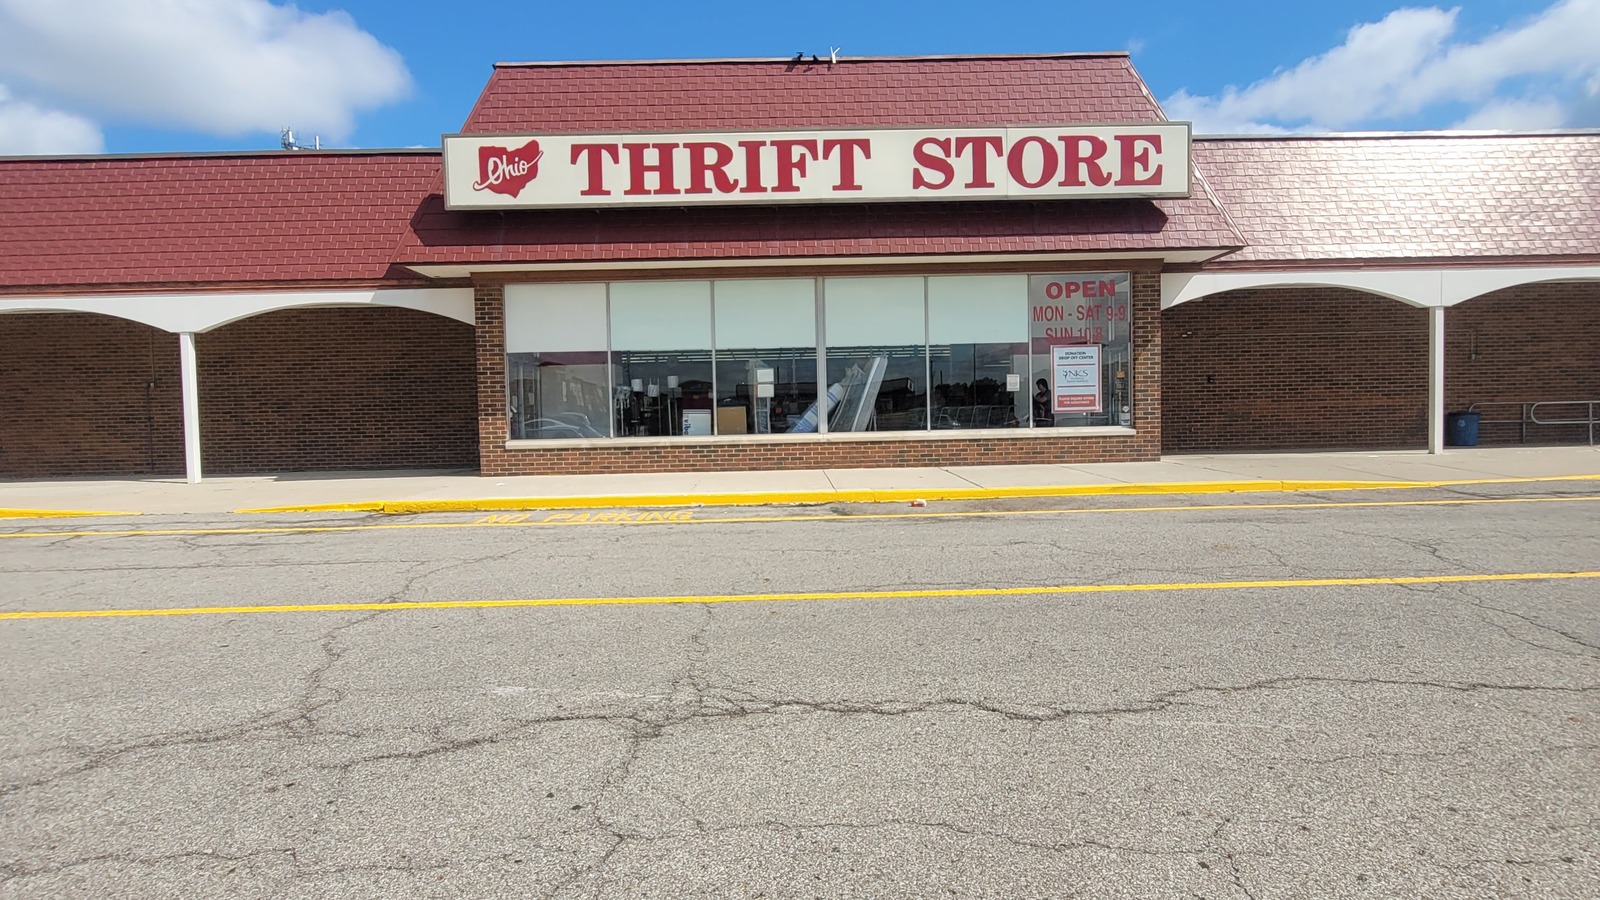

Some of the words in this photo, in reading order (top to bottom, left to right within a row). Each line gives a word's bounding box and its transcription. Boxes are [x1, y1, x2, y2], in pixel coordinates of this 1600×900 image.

[473, 150, 544, 191] Ohio
[570, 138, 871, 197] THRIFT
[912, 134, 1163, 190] STORE
[1045, 280, 1116, 300] OPEN
[1033, 305, 1064, 322] MON
[1076, 304, 1102, 321] SAT
[1106, 304, 1126, 321] 9-9
[1045, 327, 1073, 343] SUN
[475, 513, 531, 524] NO
[543, 511, 694, 523] PARKING
